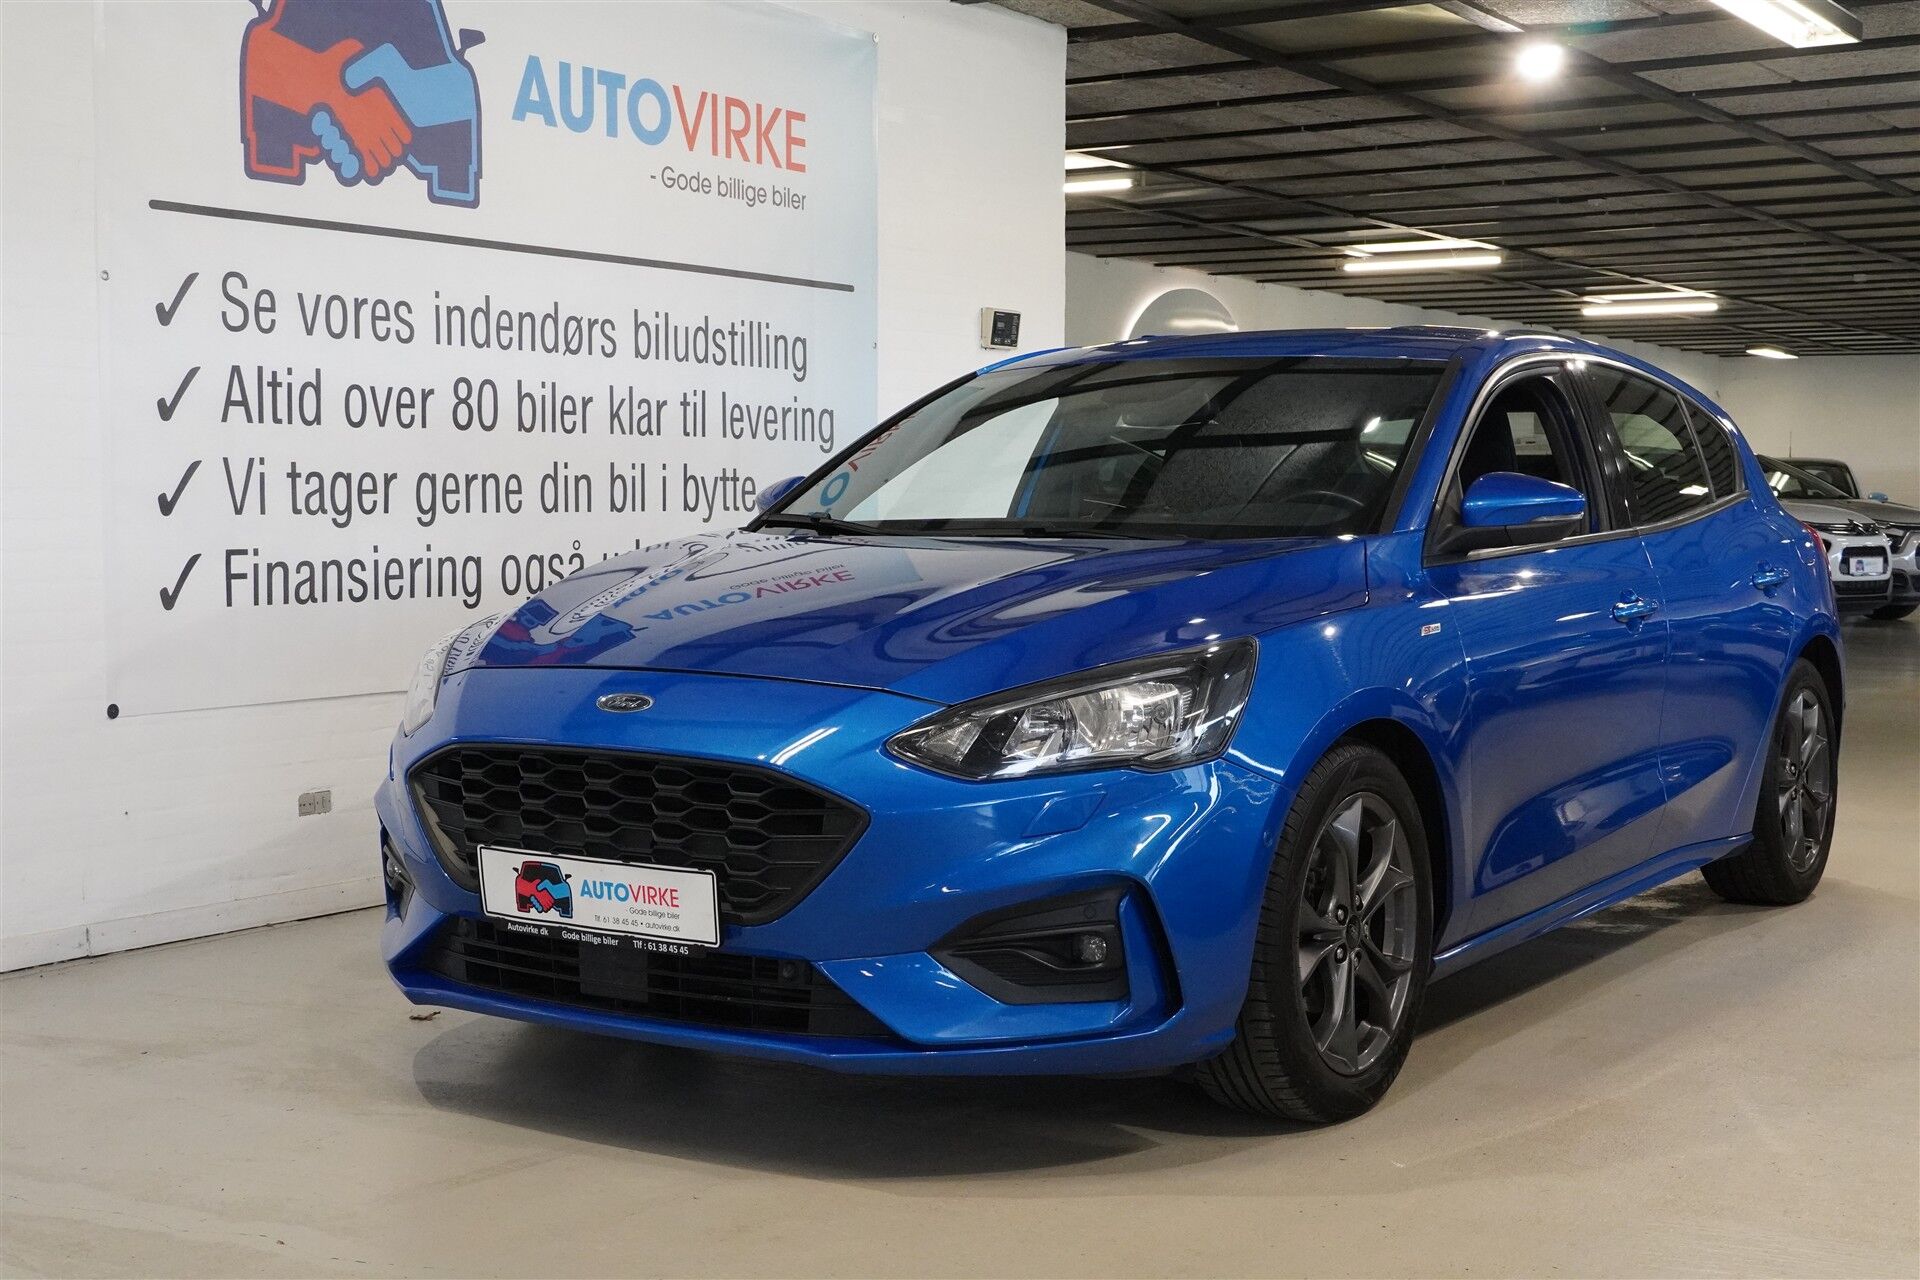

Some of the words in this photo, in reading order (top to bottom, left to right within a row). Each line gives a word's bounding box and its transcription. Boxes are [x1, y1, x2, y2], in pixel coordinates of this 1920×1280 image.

[511, 54, 807, 174] AUTOVIRKE
[660, 165, 712, 194] Gode
[717, 175, 767, 208] billige
[772, 184, 807, 211] biler
[221, 271, 277, 335] Se
[297, 292, 415, 344] vores
[434, 293, 617, 358] indendørs
[633, 308, 808, 383] biludstilling
[220, 364, 323, 427] Altid
[344, 383, 435, 430] over
[452, 376, 499, 432] 80
[517, 379, 594, 435] biler
[609, 384, 668, 437] klar
[679, 387, 706, 439] til
[721, 391, 835, 454] levering
[222, 456, 267, 516] Vi
[286, 461, 398, 529] tager
[415, 472, 523, 528] gerne
[540, 461, 592, 514] din
[609, 461, 646, 514] bil
[661, 463, 667, 512] i
[682, 462, 757, 524] bytte
[225, 545, 482, 610] Finansiering
[579, 878, 680, 908] AUTOVIRKE
[628, 906, 648, 917] Gode
[648, 909, 666, 920] billige
[666, 911, 680, 920] biler
[507, 922, 539, 935] Autovirke
[561, 930, 580, 941] Gode
[581, 932, 602, 945] billige
[602, 935, 619, 947] biler
[647, 941, 657, 952] 61
[657, 943, 668, 953] 38
[668, 944, 678, 954] 45
[679, 945, 689, 956] 45
[602, 916, 610, 924] 61
[612, 917, 620, 925] 38
[621, 918, 630, 926] 45
[630, 919, 639, 928] 45
